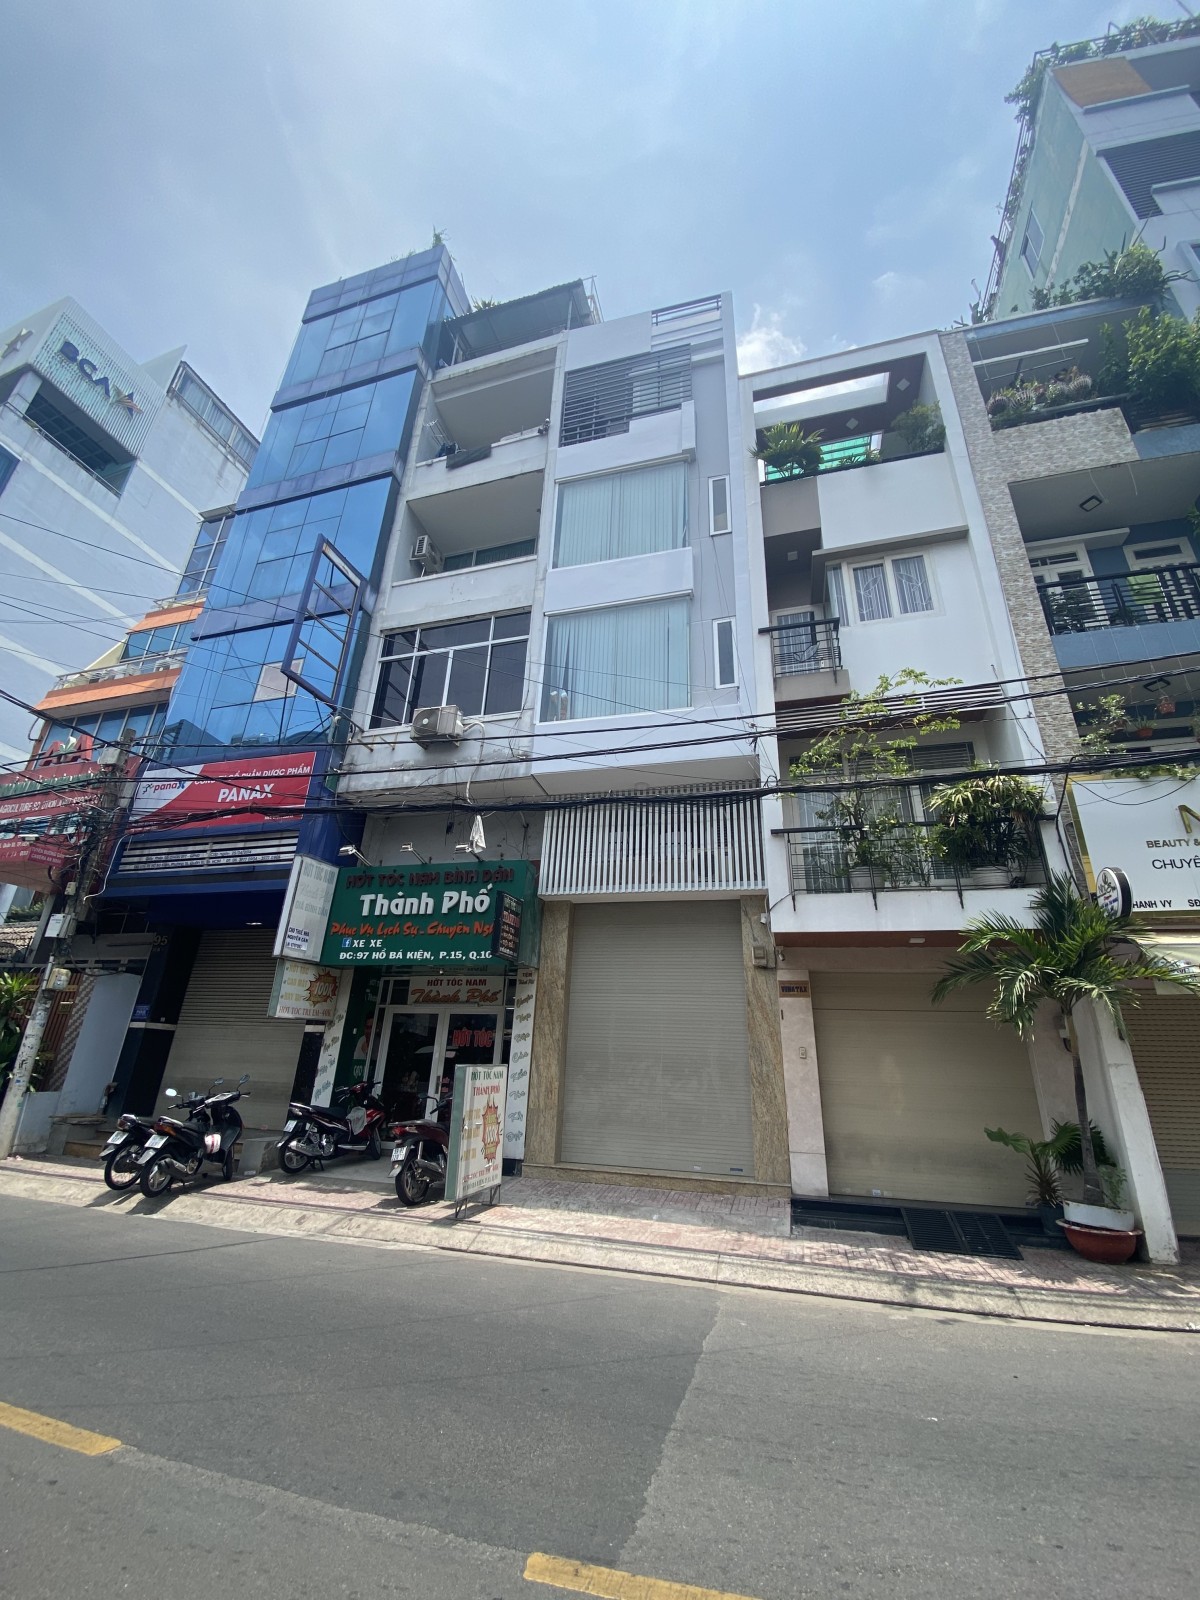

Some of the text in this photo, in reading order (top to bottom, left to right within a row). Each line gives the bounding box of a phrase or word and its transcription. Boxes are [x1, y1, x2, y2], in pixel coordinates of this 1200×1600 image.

[217, 783, 275, 802] PANAX
[1146, 838, 1190, 849] BEAUTY
[379, 868, 405, 888] TÓC
[441, 883, 493, 914] Phố
[1159, 899, 1173, 908] VY
[427, 921, 470, 939] Chuyên
[352, 939, 383, 948] XE XE
[339, 951, 369, 960] ĐC:97
[389, 949, 403, 960] BÁ
[439, 950, 466, 961] P.15,
[427, 976, 487, 987] HỚT TÓC NAM
[411, 988, 502, 1004] Thành Phố
[453, 1026, 472, 1047] HỚT
[473, 1026, 493, 1048] TÓC
